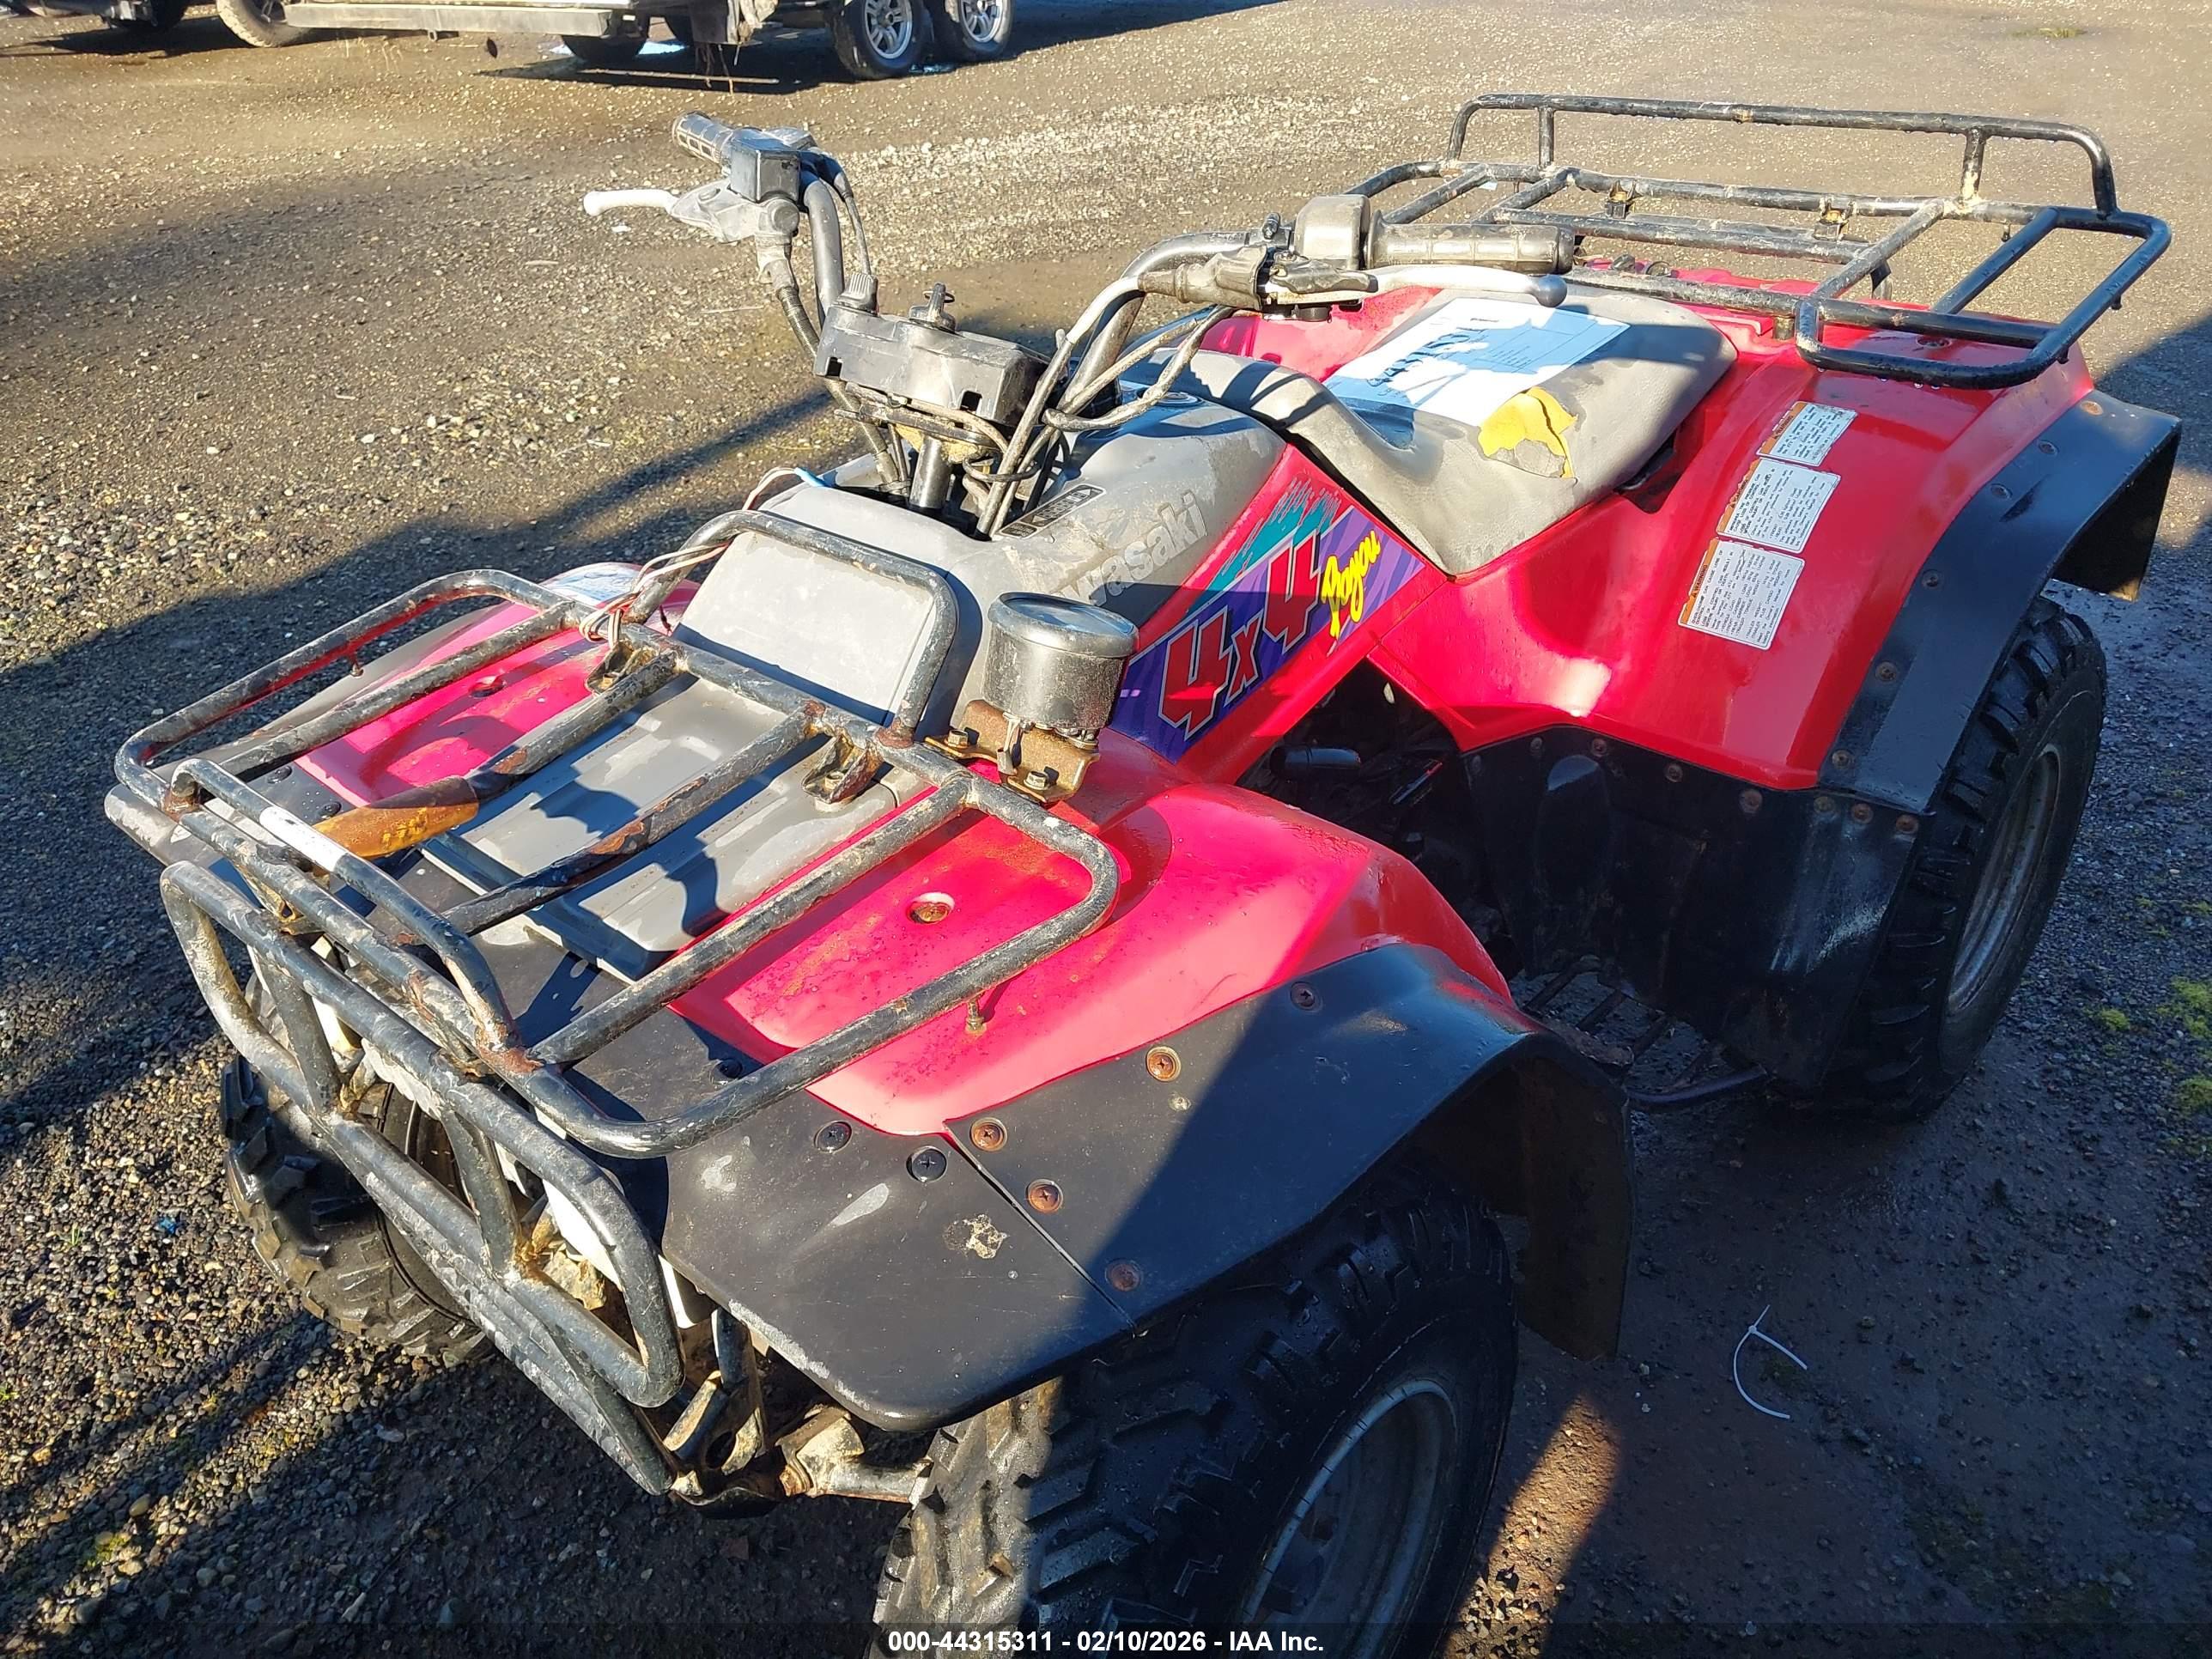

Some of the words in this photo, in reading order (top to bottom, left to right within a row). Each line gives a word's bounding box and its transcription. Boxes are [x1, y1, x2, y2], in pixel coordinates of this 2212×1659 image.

[1051, 489, 1208, 606] wasaki
[1694, 565, 1708, 591] WARNING
[1158, 529, 1322, 742] 4x4
